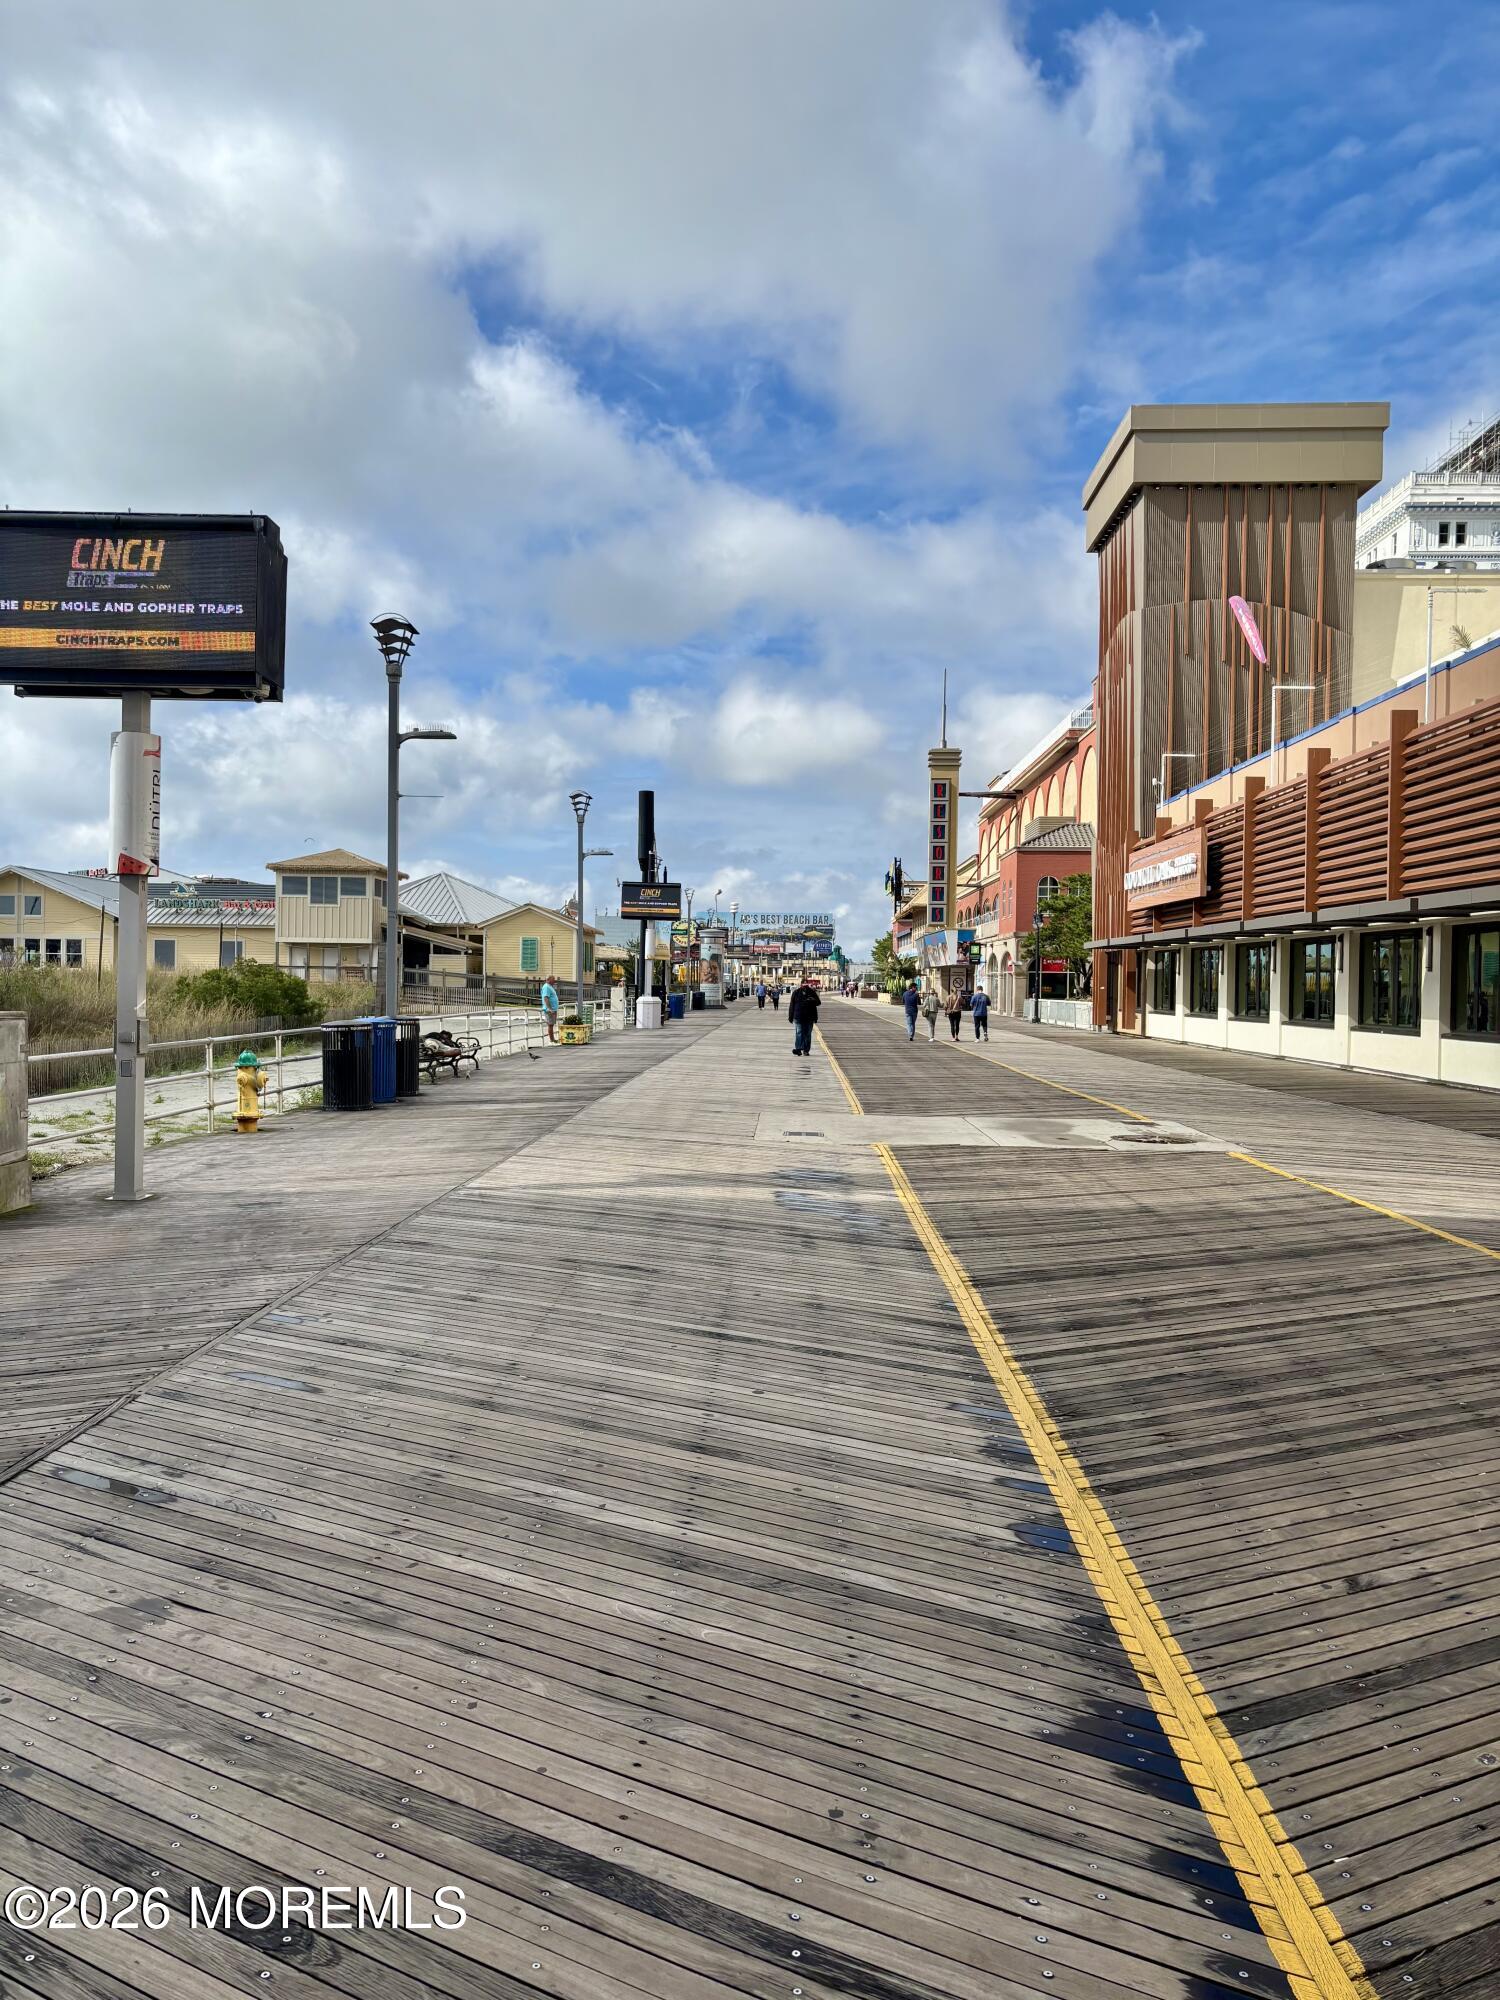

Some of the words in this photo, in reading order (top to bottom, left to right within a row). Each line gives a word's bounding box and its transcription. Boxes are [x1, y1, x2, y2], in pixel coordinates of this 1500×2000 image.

[72, 539, 165, 570] CINCH
[23, 601, 58, 612] BEST
[61, 601, 100, 612] MOLE
[103, 602, 133, 613] AND
[138, 603, 195, 614] GOPHER
[199, 604, 244, 615] TRAPS
[56, 634, 180, 646] CINCHTRAPS.COM
[934, 783, 945, 923] RESORTS
[761, 915, 780, 924] BEST
[783, 915, 810, 924] BEACH
[812, 914, 829, 924] BAR
